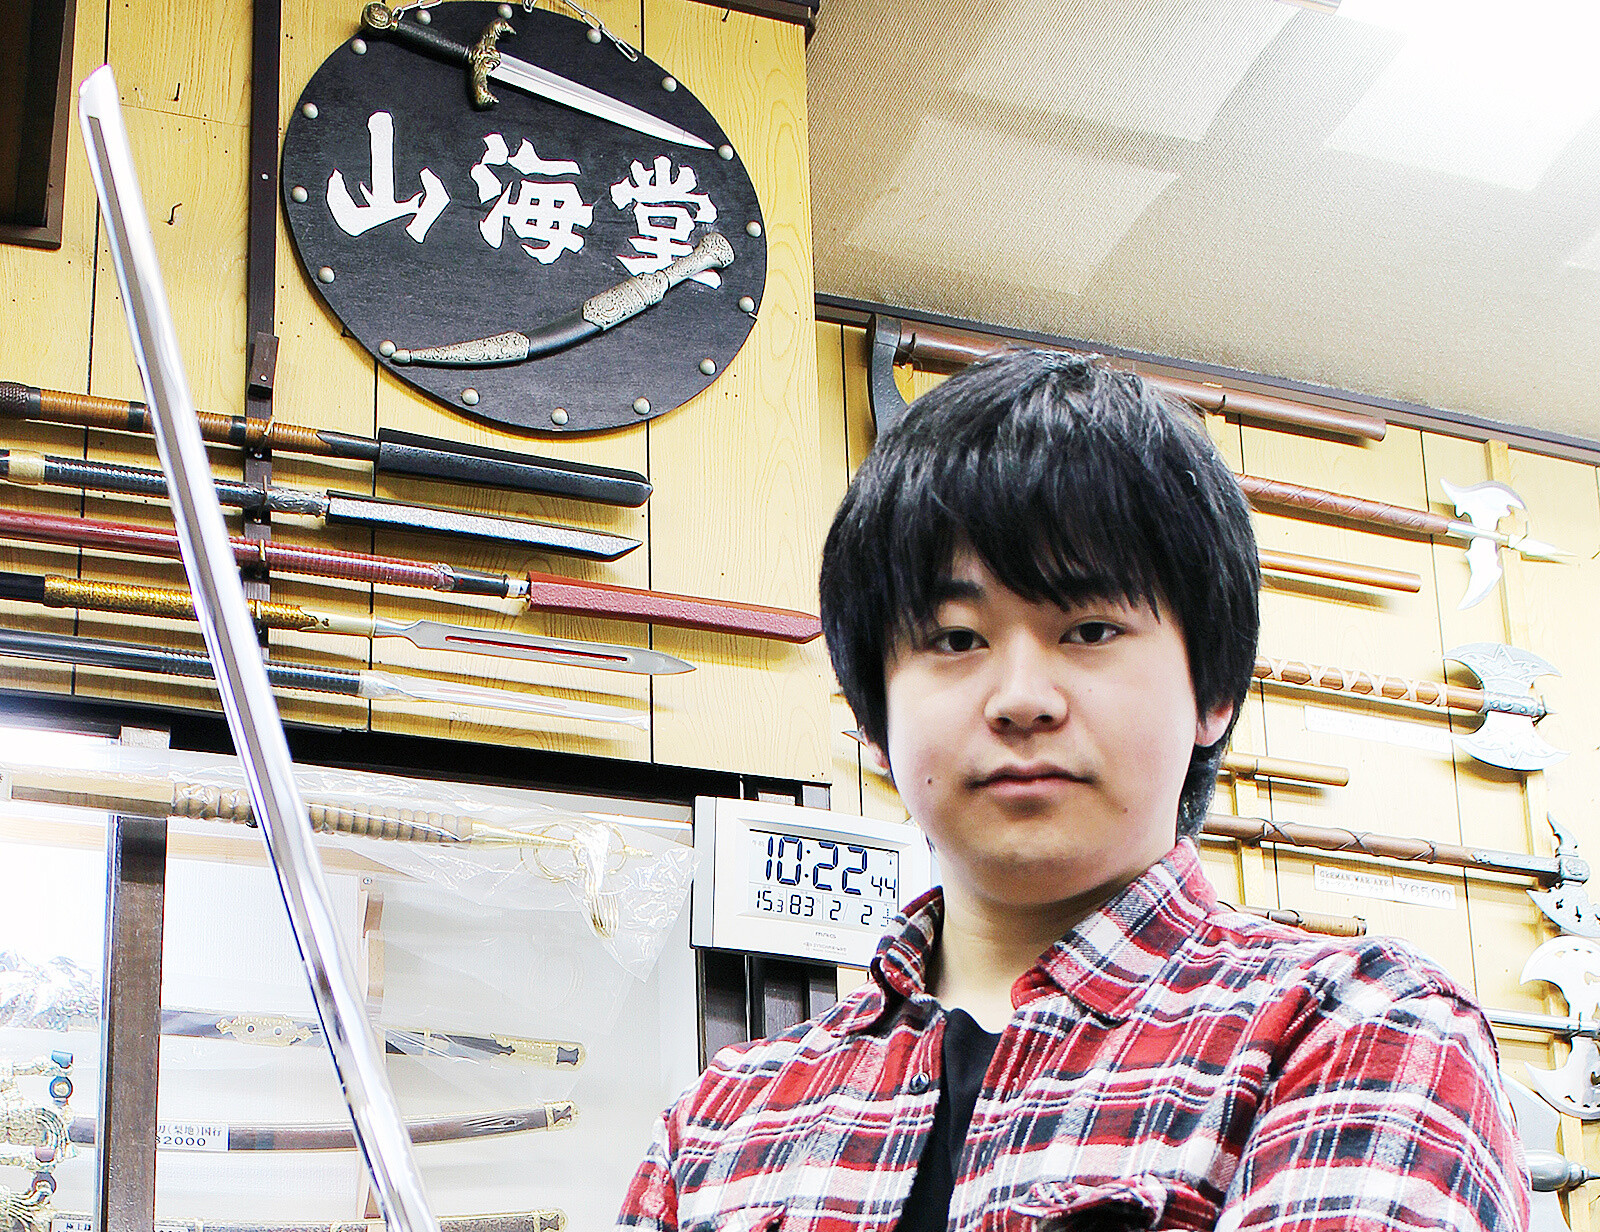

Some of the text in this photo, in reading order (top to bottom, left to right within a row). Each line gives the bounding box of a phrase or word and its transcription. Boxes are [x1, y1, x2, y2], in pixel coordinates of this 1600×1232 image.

[326, 110, 722, 289] 山海堂
[766, 836, 896, 898] 10:22 44
[756, 890, 784, 913] 15.3
[789, 894, 815, 917] 83
